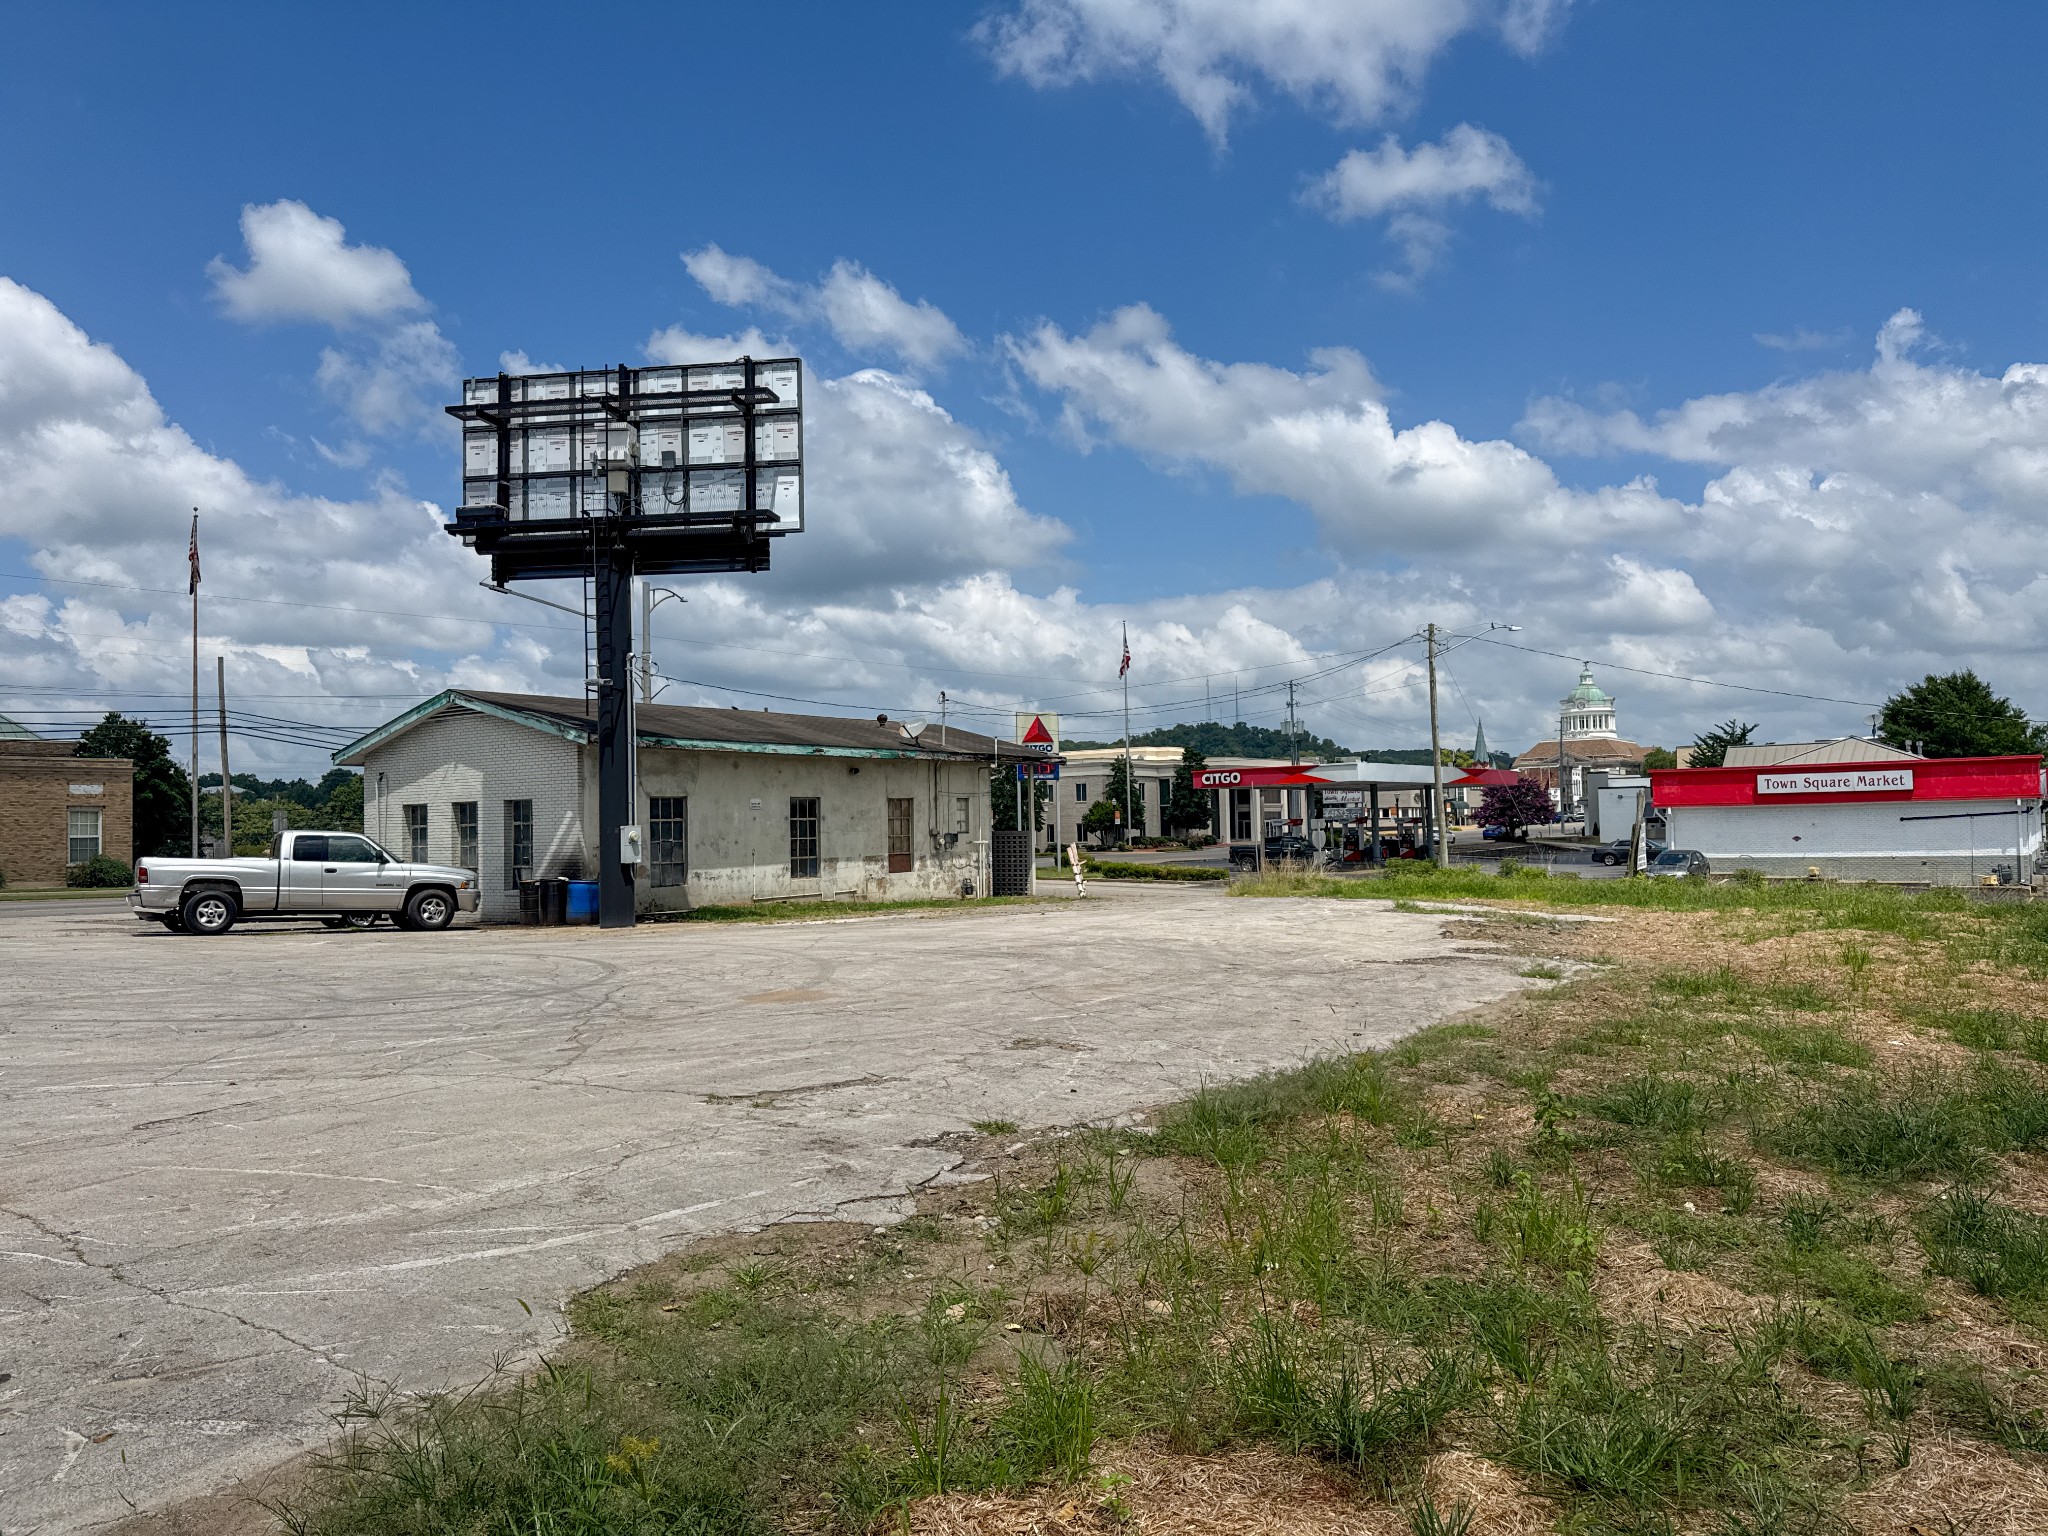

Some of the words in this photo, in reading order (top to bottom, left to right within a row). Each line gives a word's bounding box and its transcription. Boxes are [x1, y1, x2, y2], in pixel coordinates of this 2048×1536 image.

[1201, 772, 1241, 785] CITGO
[1764, 778, 1798, 790] Town
[1803, 777, 1851, 791] Square
[1856, 774, 1906, 787] Market
